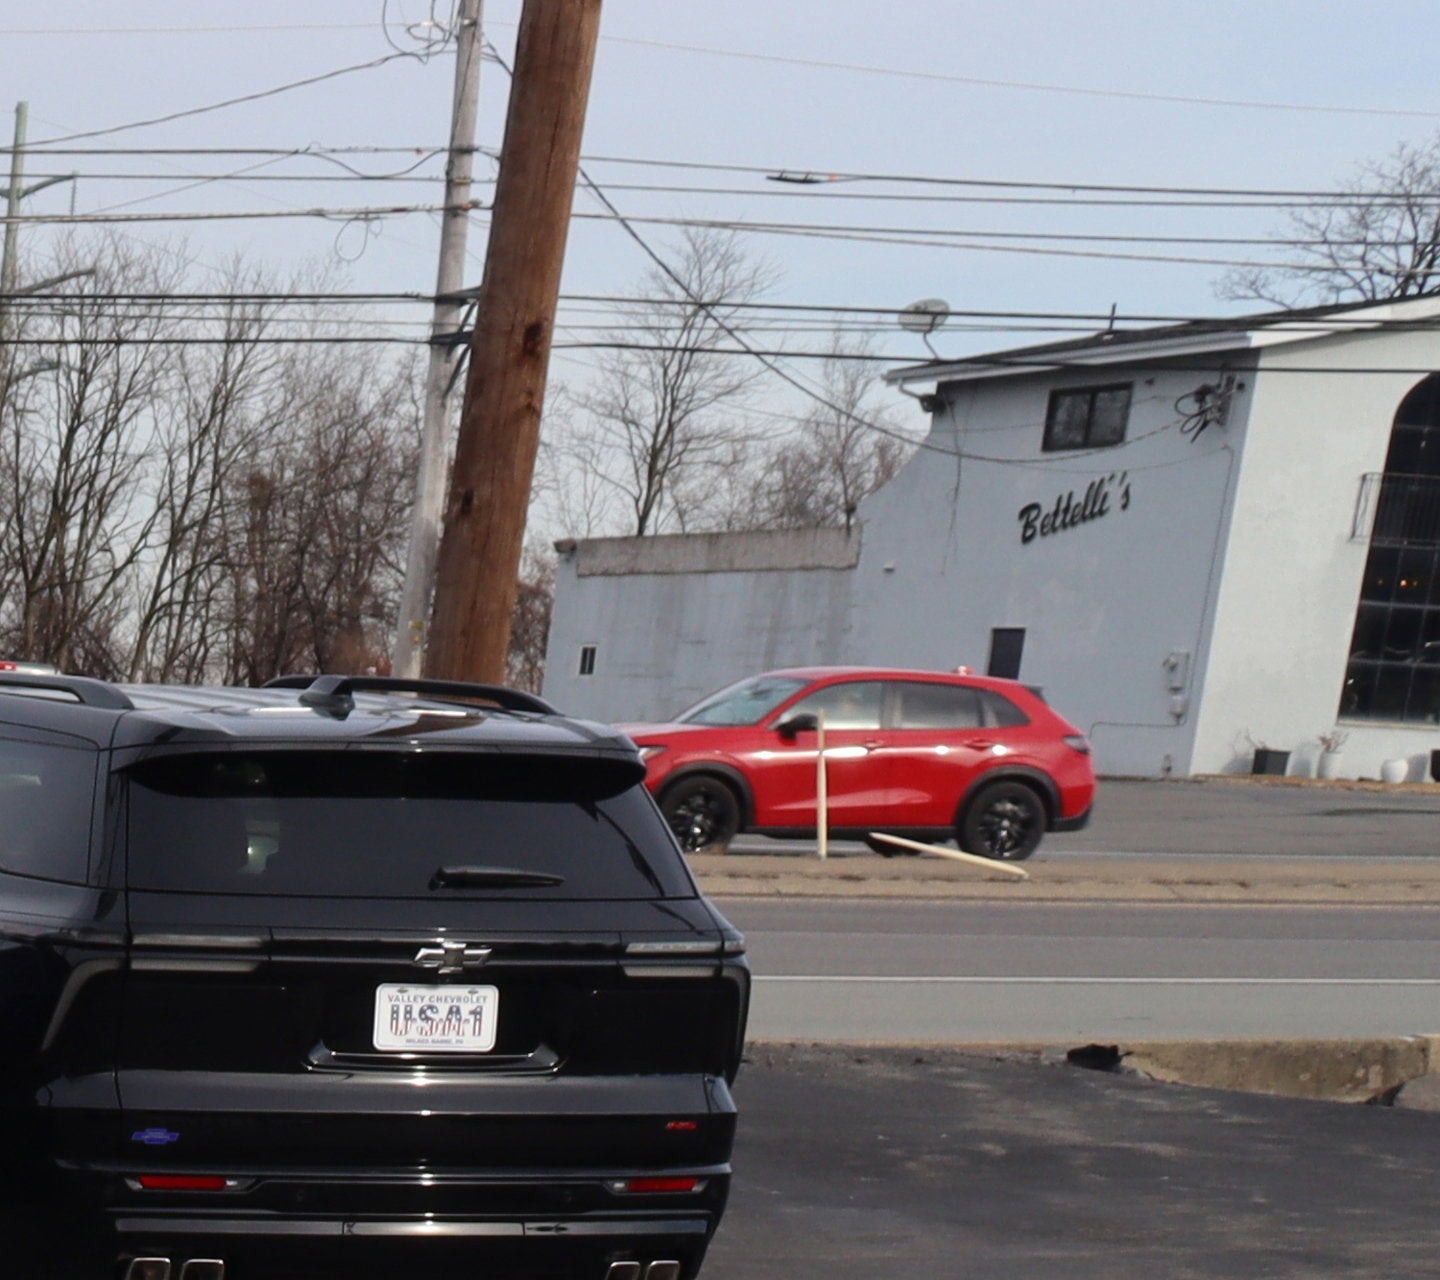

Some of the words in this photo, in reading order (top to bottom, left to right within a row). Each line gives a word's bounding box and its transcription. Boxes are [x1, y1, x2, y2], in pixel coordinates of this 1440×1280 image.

[1018, 471, 1130, 544] Bettelli's
[388, 994, 426, 1003] VALLEY
[428, 995, 488, 1004] CHEVROLET
